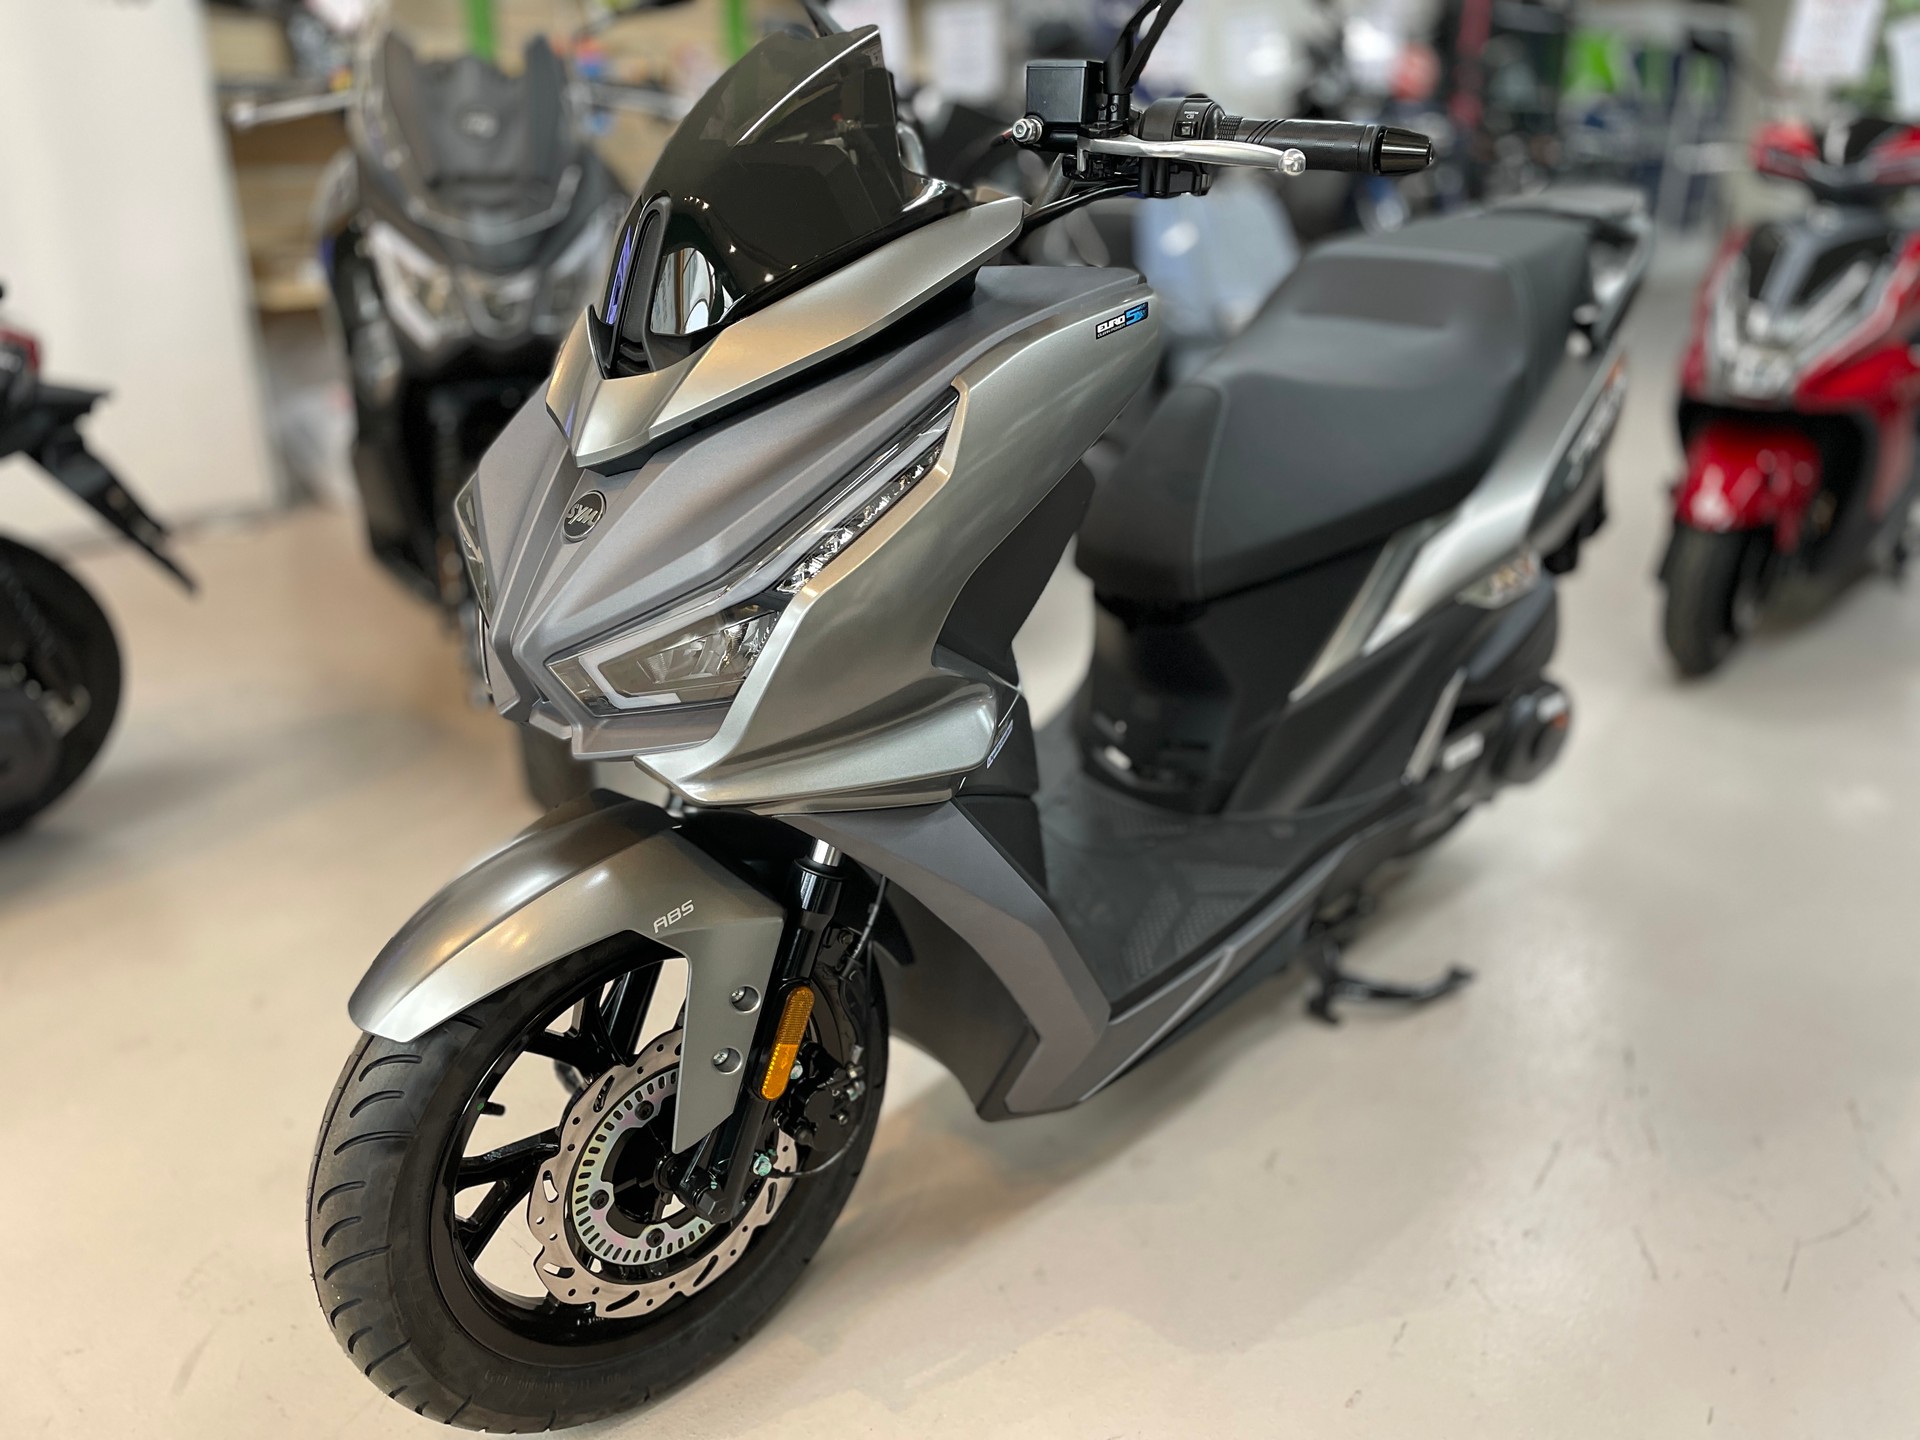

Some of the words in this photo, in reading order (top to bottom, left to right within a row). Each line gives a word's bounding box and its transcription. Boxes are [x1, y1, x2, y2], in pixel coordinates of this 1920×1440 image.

[1097, 315, 1125, 333] EURO
[1126, 303, 1145, 325] 5
[567, 503, 599, 527] SYM
[653, 899, 694, 934] ABS
